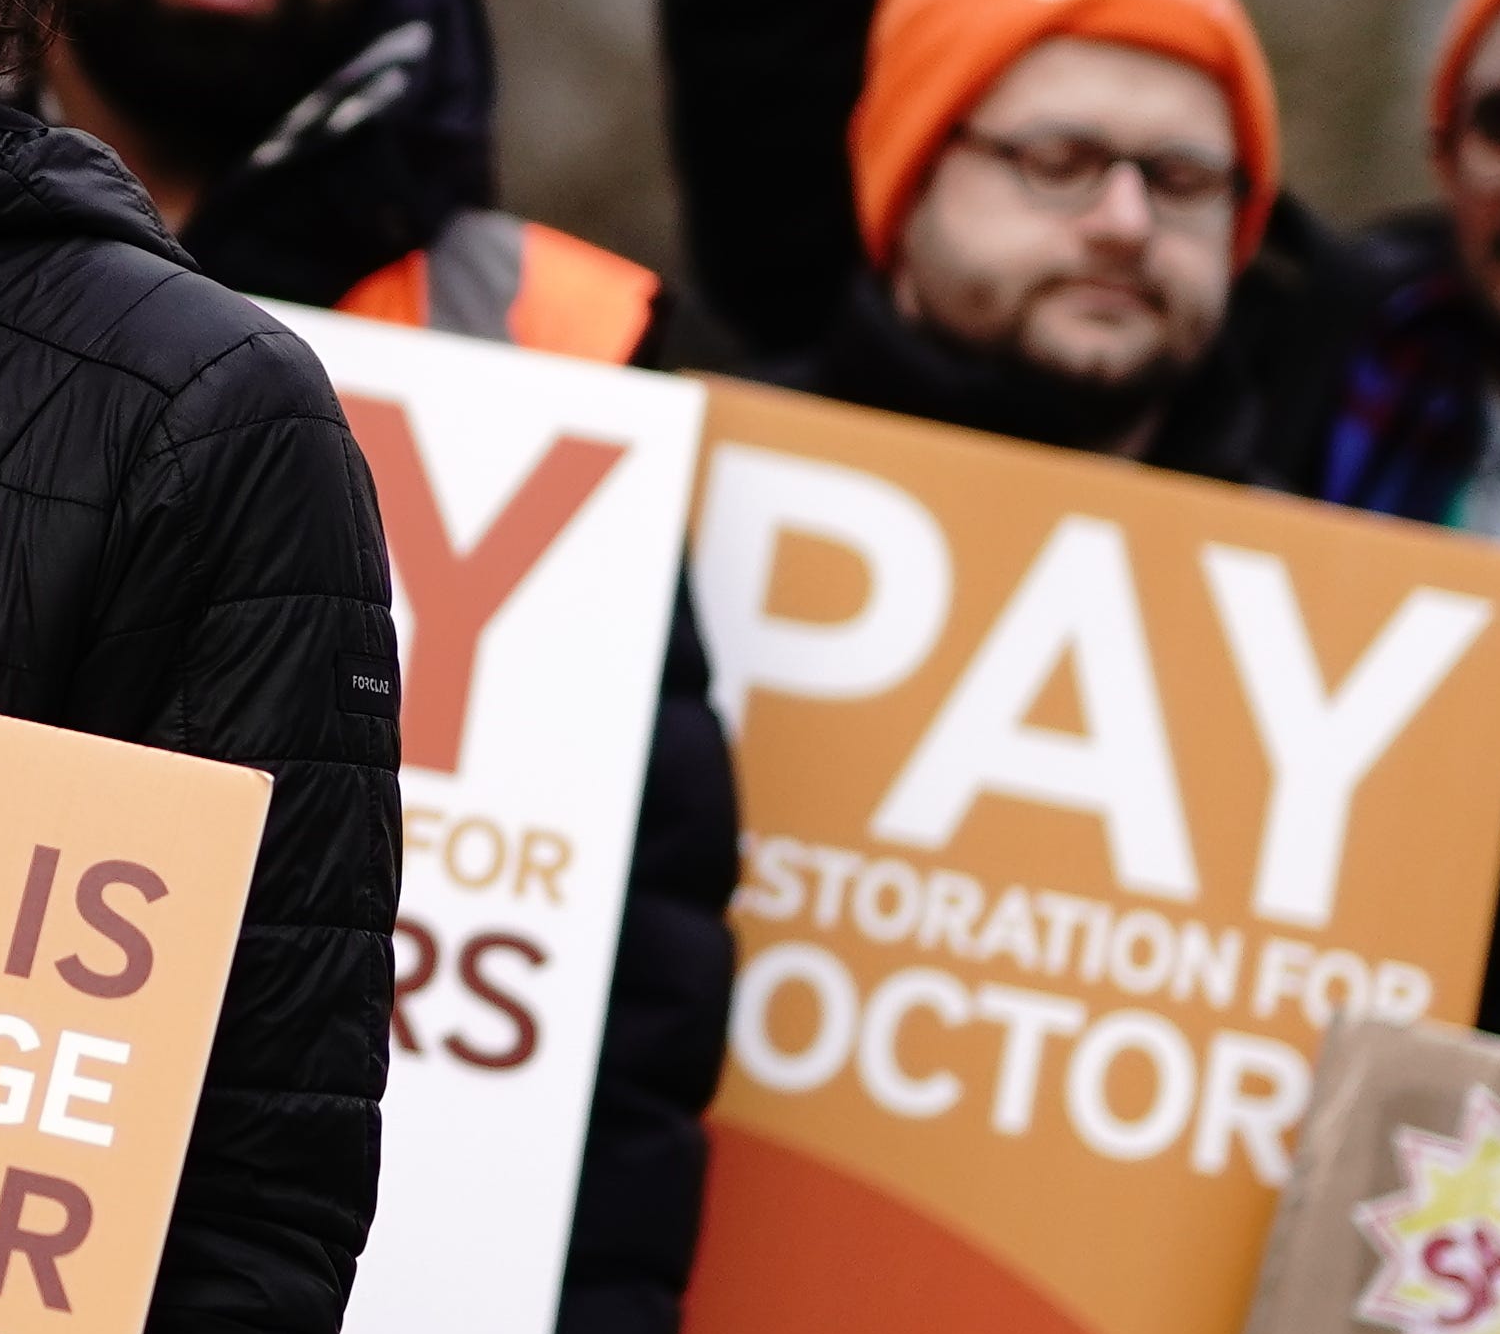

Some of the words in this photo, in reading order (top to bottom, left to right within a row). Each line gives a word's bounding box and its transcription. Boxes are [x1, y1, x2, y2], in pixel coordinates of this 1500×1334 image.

[352, 674, 390, 695] FORCLAZ
[693, 442, 1495, 928] PAY
[5, 845, 171, 999] IS
[735, 838, 1242, 1009] STORATION
